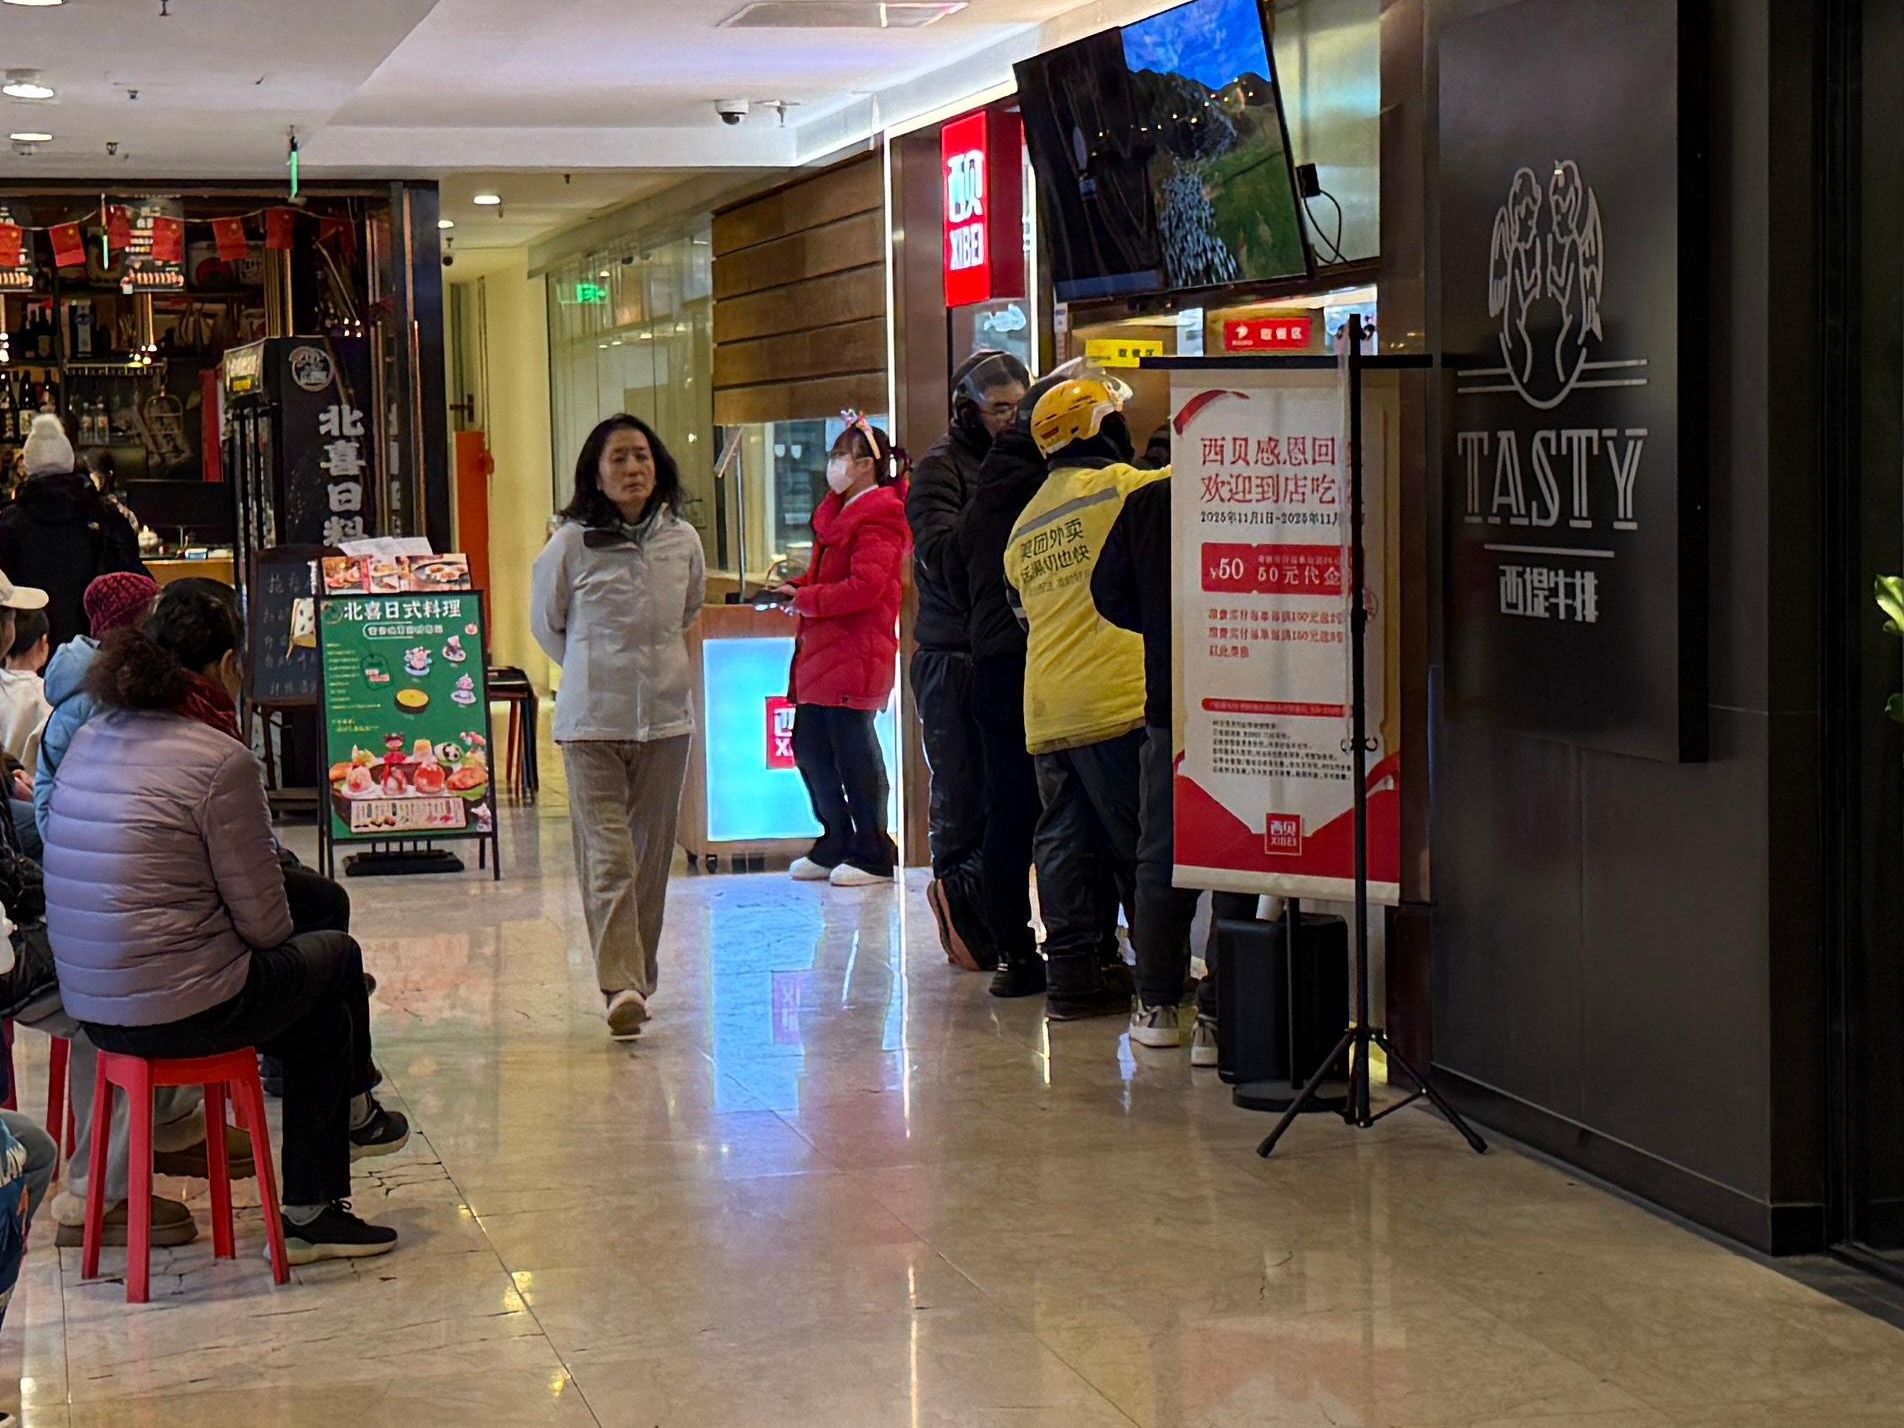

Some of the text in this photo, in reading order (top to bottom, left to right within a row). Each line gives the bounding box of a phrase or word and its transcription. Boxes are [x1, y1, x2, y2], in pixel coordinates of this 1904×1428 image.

[949, 222, 985, 271] XIBEI
[1200, 435, 1336, 467] 西贝感恩回
[319, 404, 370, 548] 北喜日料
[1200, 473, 1336, 505] 欢迎到店吃
[1457, 428, 1649, 531] TASTY
[1020, 518, 1085, 562] 美团外卖
[1257, 565, 1341, 586] 50元代金
[1499, 565, 1599, 623] 西堤牛排
[343, 599, 462, 622] 北喜日式料理
